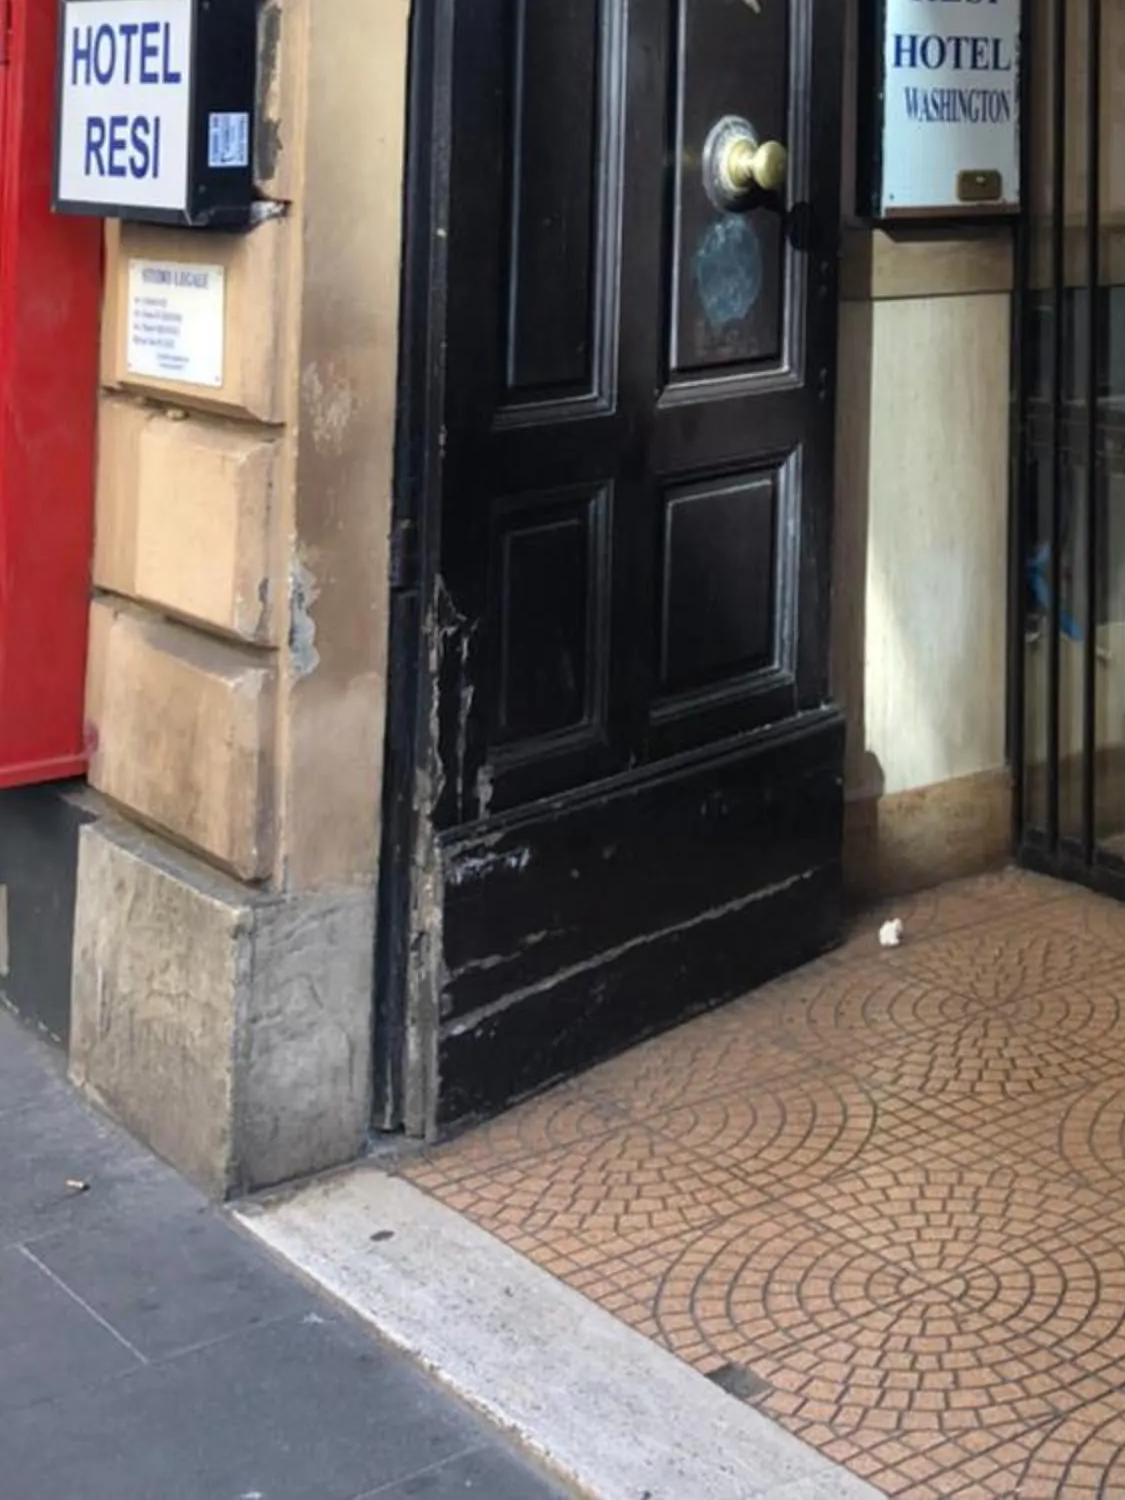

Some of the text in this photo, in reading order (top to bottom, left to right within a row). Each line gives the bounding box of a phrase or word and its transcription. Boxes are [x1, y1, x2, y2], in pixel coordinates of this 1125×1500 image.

[71, 21, 182, 86] HOTEL
[892, 33, 1012, 73] HOTEL
[904, 86, 1012, 125] WASHINGTON
[84, 115, 161, 180] RESI
